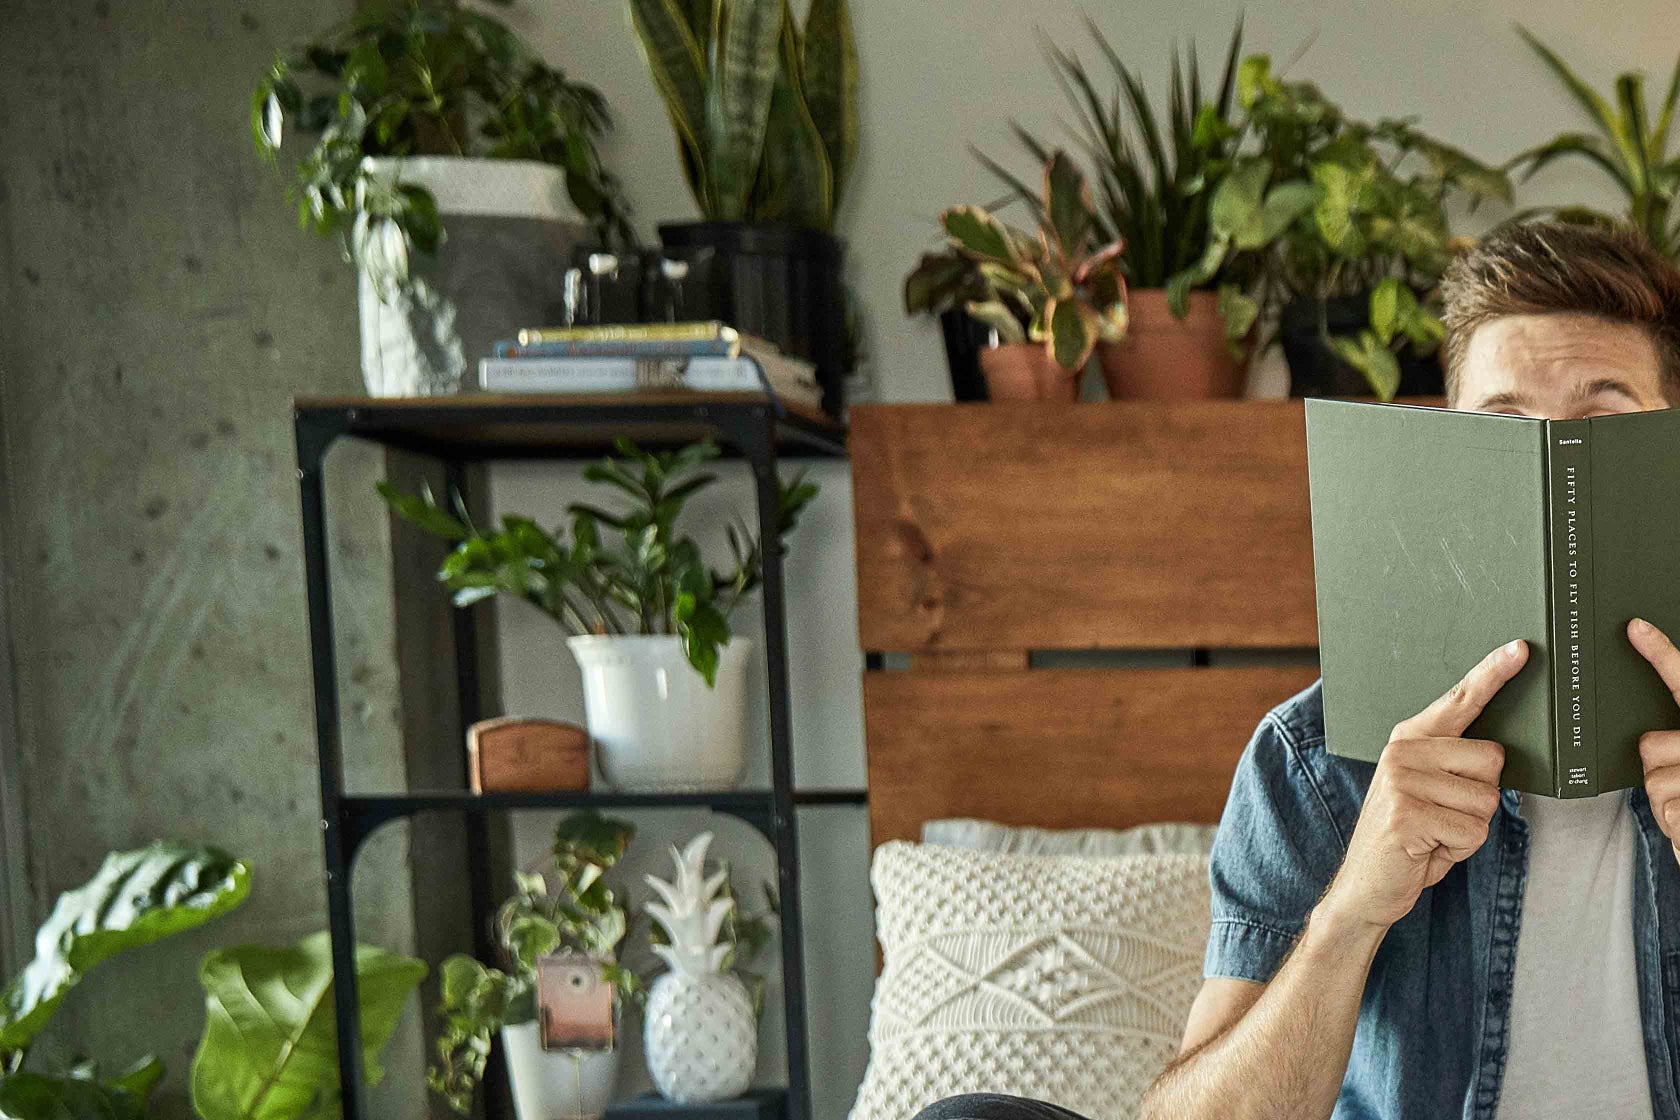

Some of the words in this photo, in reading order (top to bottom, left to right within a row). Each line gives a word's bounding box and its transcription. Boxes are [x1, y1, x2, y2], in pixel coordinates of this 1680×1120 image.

[1566, 467, 1576, 504] FIFTY
[1567, 510, 1577, 557] PLACES
[1569, 560, 1578, 578] TO
[1569, 583, 1578, 605] FLY
[1570, 610, 1579, 639] FISH
[1571, 644, 1581, 692] BEFORE
[1572, 695, 1582, 721] YOU
[1573, 726, 1582, 747] DIE
